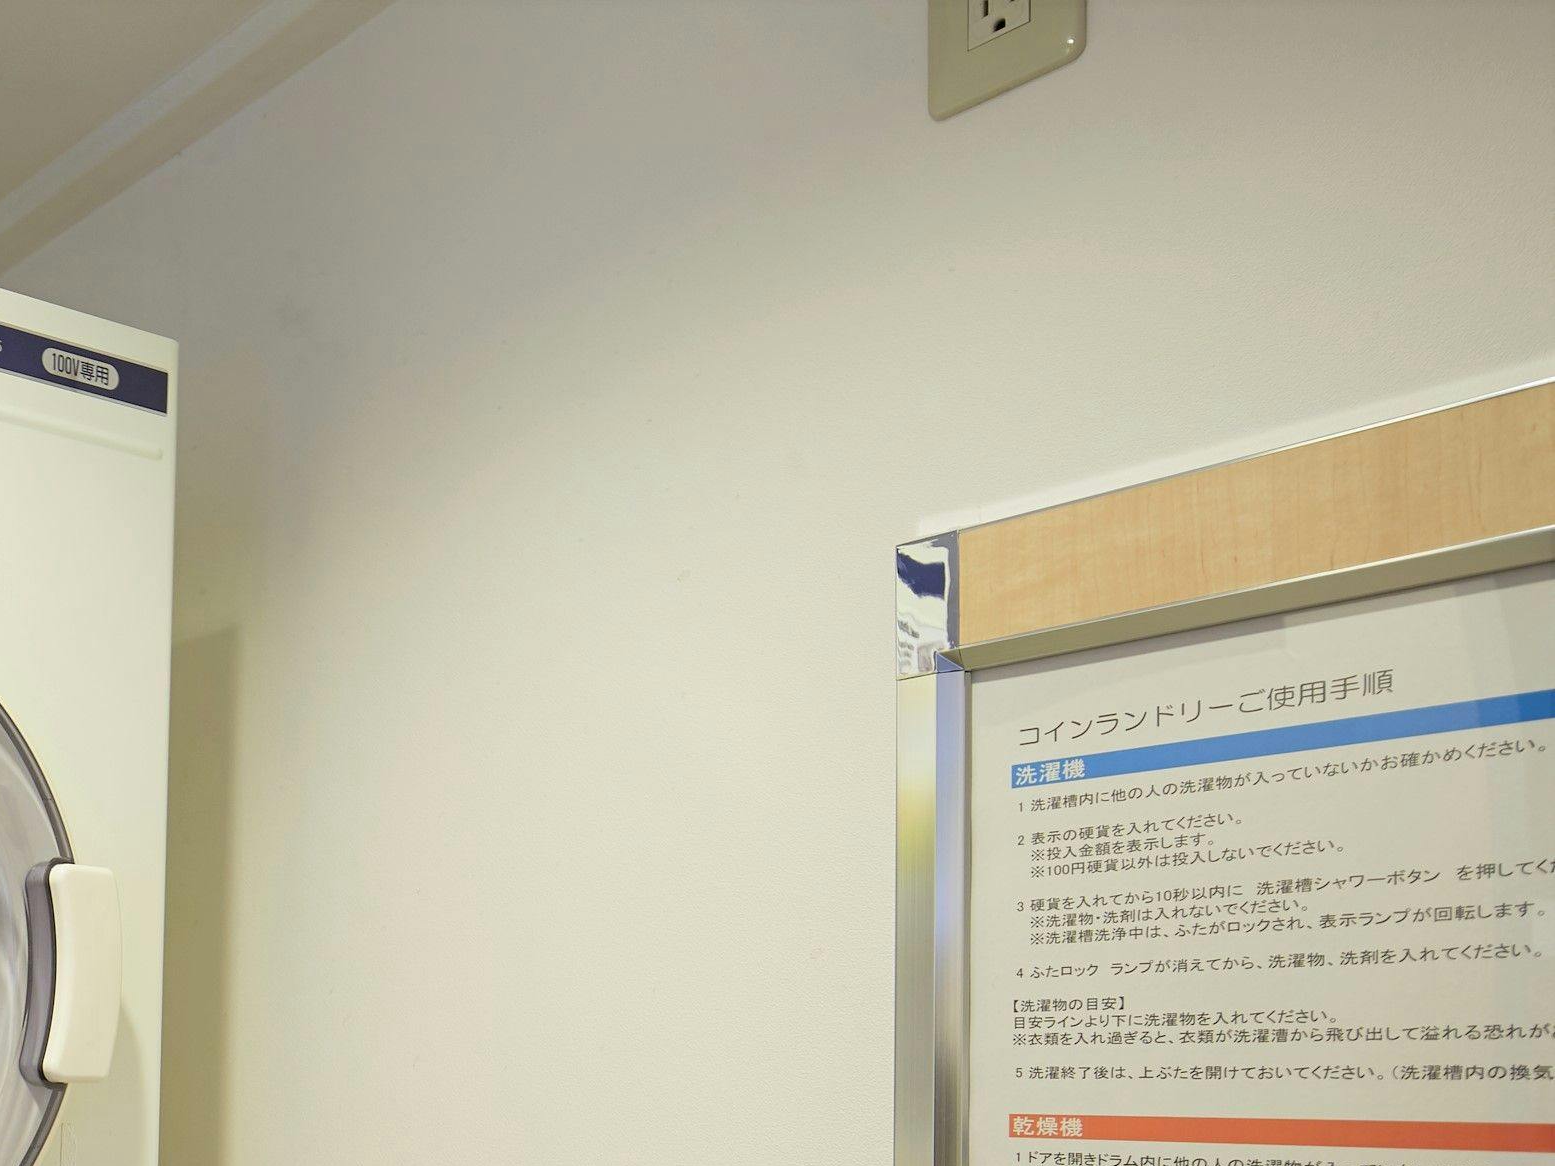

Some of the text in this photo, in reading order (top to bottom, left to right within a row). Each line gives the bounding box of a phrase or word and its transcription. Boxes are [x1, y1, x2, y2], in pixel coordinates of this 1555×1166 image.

[51, 351, 110, 387] 100V専用
[1018, 669, 1395, 745] コインランドリーご使用手順
[1015, 759, 1086, 785] 洗濯機
[1018, 741, 1547, 813] 1 洗濯槽内に他の人の洗濯物が入っていないかお確かめください。
[1017, 813, 1243, 846] 2 表示の硬貨を入れてください。
[1031, 834, 1215, 861] ※投入金額を表示します。
[1031, 842, 1345, 878] ※100円硬貨以外は投入しないでください。
[1017, 902, 1024, 912] 3
[1031, 883, 1242, 912] 硬貨を入れてから10秒以内に
[1256, 867, 1440, 896] 洗濯槽シャワーボタン
[1031, 899, 1309, 928] ※洗濯物・洗剤は入れないでください。
[1031, 900, 1546, 945] ※洗濯槽洗浄中は、ふたがロックされ、表示ランプが回転します。
[1016, 941, 1542, 978] 4 ふたロック ランプが消えてから、洗濯物、洗剤を入れてください。
[1013, 997, 1126, 1013] 【洗濯物の目安】
[1013, 1008, 1337, 1029] 目安ラインより下に洗濯物を入れてください。
[1013, 1023, 1555, 1046] ※衣類を入れ過ぎると、衣類が洗濯漕から飛び出して溢れる恐れが
[1016, 1067, 1024, 1078] 5
[1013, 1117, 1084, 1139] 乾燥機
[1016, 1153, 1022, 1163] 1
